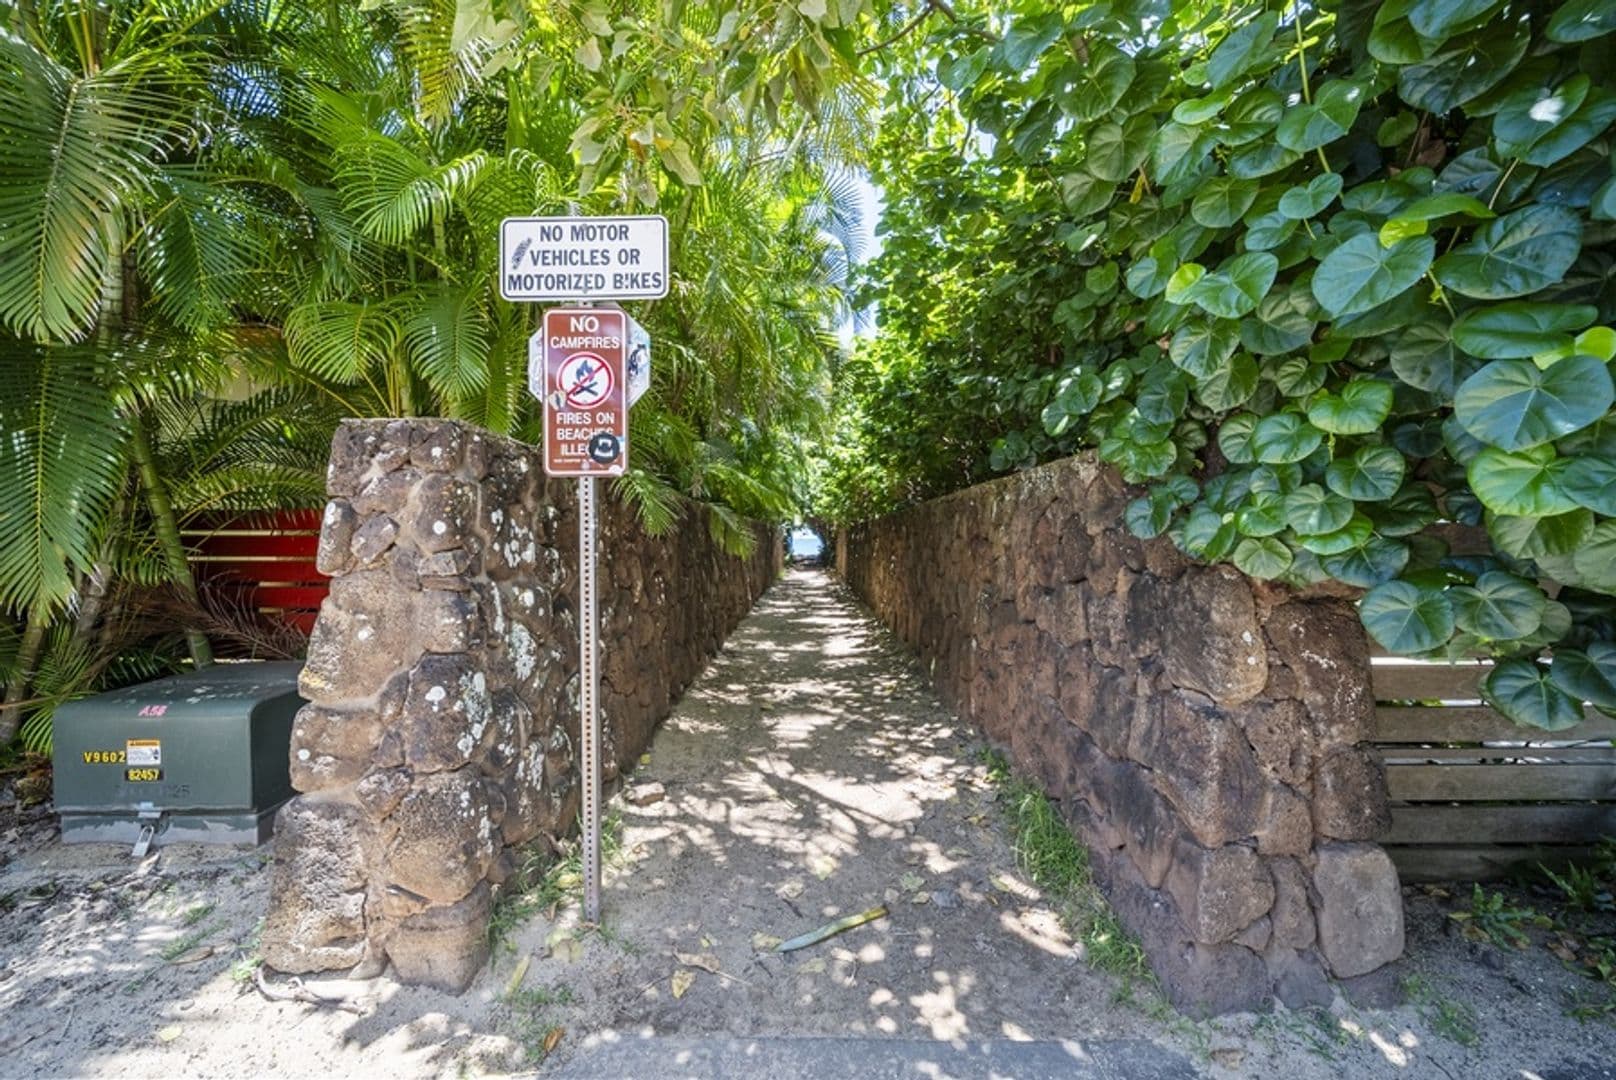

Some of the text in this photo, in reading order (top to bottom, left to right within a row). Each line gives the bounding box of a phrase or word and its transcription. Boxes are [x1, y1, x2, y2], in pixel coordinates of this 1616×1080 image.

[540, 224, 630, 242] NO MOTOR
[530, 248, 640, 266] VEHICLES OR
[508, 271, 662, 291] MOTORIZED BIKES
[570, 316, 599, 332] NO
[550, 336, 620, 348] CAMPFIRES
[556, 412, 615, 425] FIRES ON
[556, 427, 614, 440] BEACH
[83, 751, 126, 763] V9602
